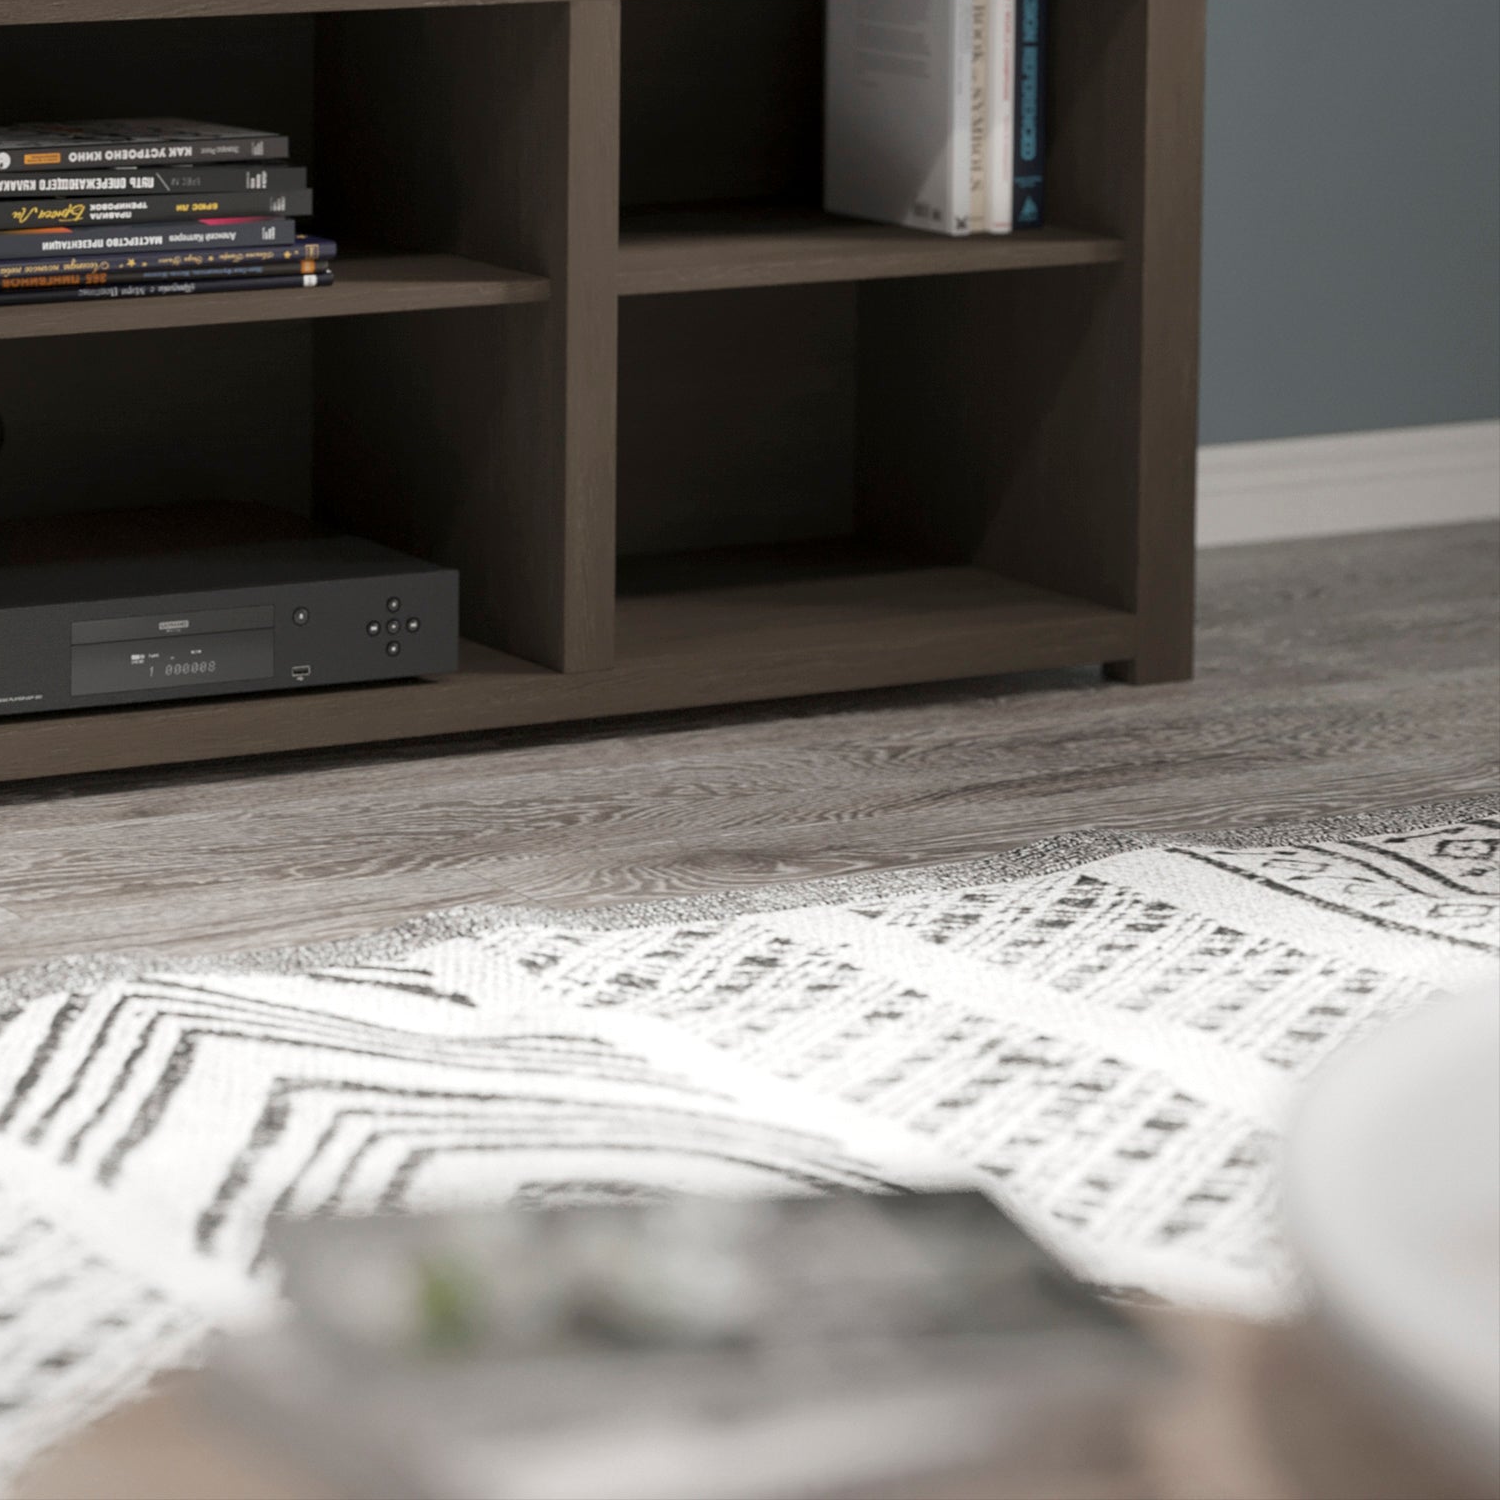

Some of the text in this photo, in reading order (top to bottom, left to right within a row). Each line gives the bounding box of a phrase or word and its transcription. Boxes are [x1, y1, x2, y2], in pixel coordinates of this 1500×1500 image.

[68, 150, 102, 163] КИНО
[104, 147, 167, 161] УСТРОЕНО
[168, 146, 193, 158] КАК
[38, 177, 127, 191] ОПЕРЕЖАЮЩЕГО
[129, 176, 155, 189] ПУТЬ
[89, 201, 149, 211] ТРЕНИРОВОК
[191, 202, 218, 212] БРЮС
[89, 211, 133, 220] ПРАВИЛА
[42, 235, 163, 251] МАСТЕРСТВО ПРЕЗЕНТАЦИИ
